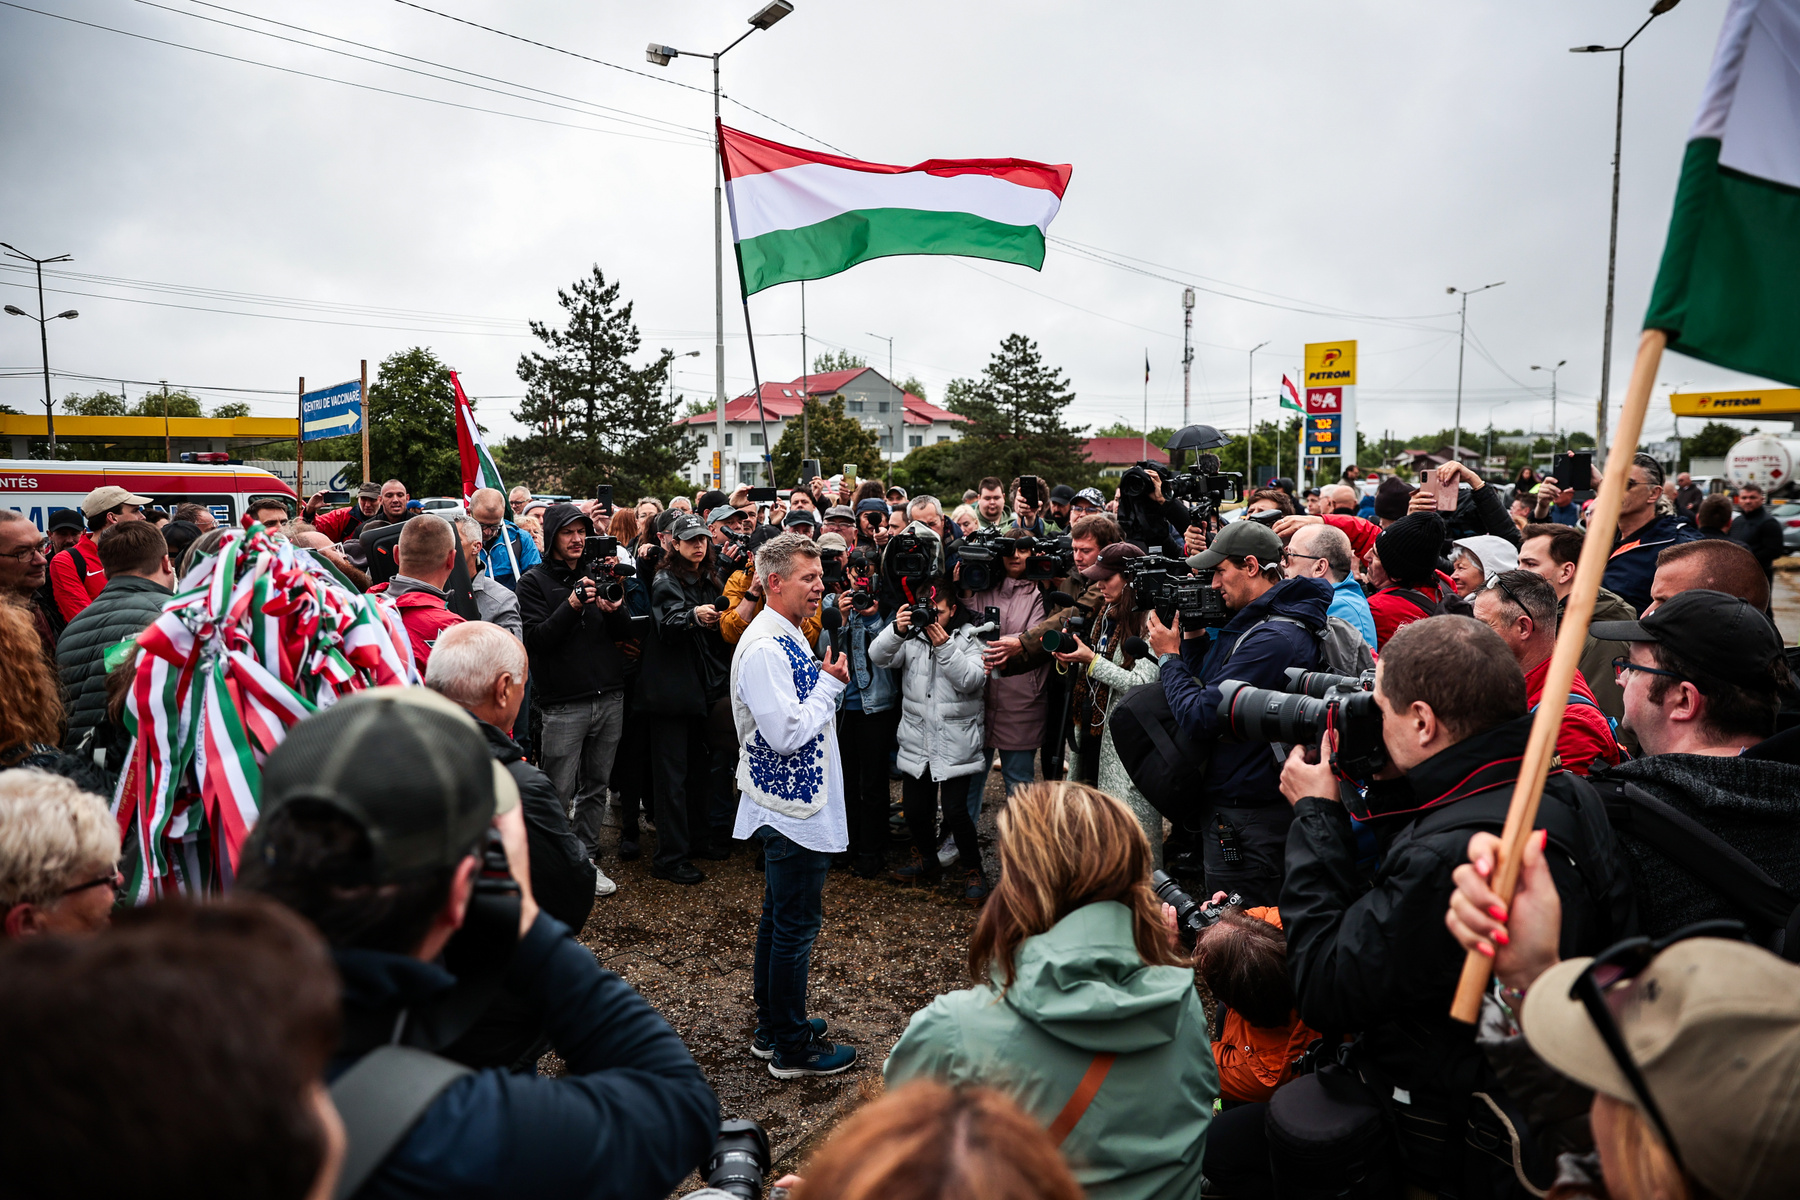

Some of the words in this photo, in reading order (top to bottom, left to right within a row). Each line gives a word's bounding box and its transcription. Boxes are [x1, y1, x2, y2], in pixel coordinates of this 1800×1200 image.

[1309, 370, 1351, 380] PETROM
[303, 399, 322, 412] CENTRU
[322, 397, 331, 408] DE
[330, 389, 360, 407] VACCINARE
[1713, 397, 1762, 407] PETROM
